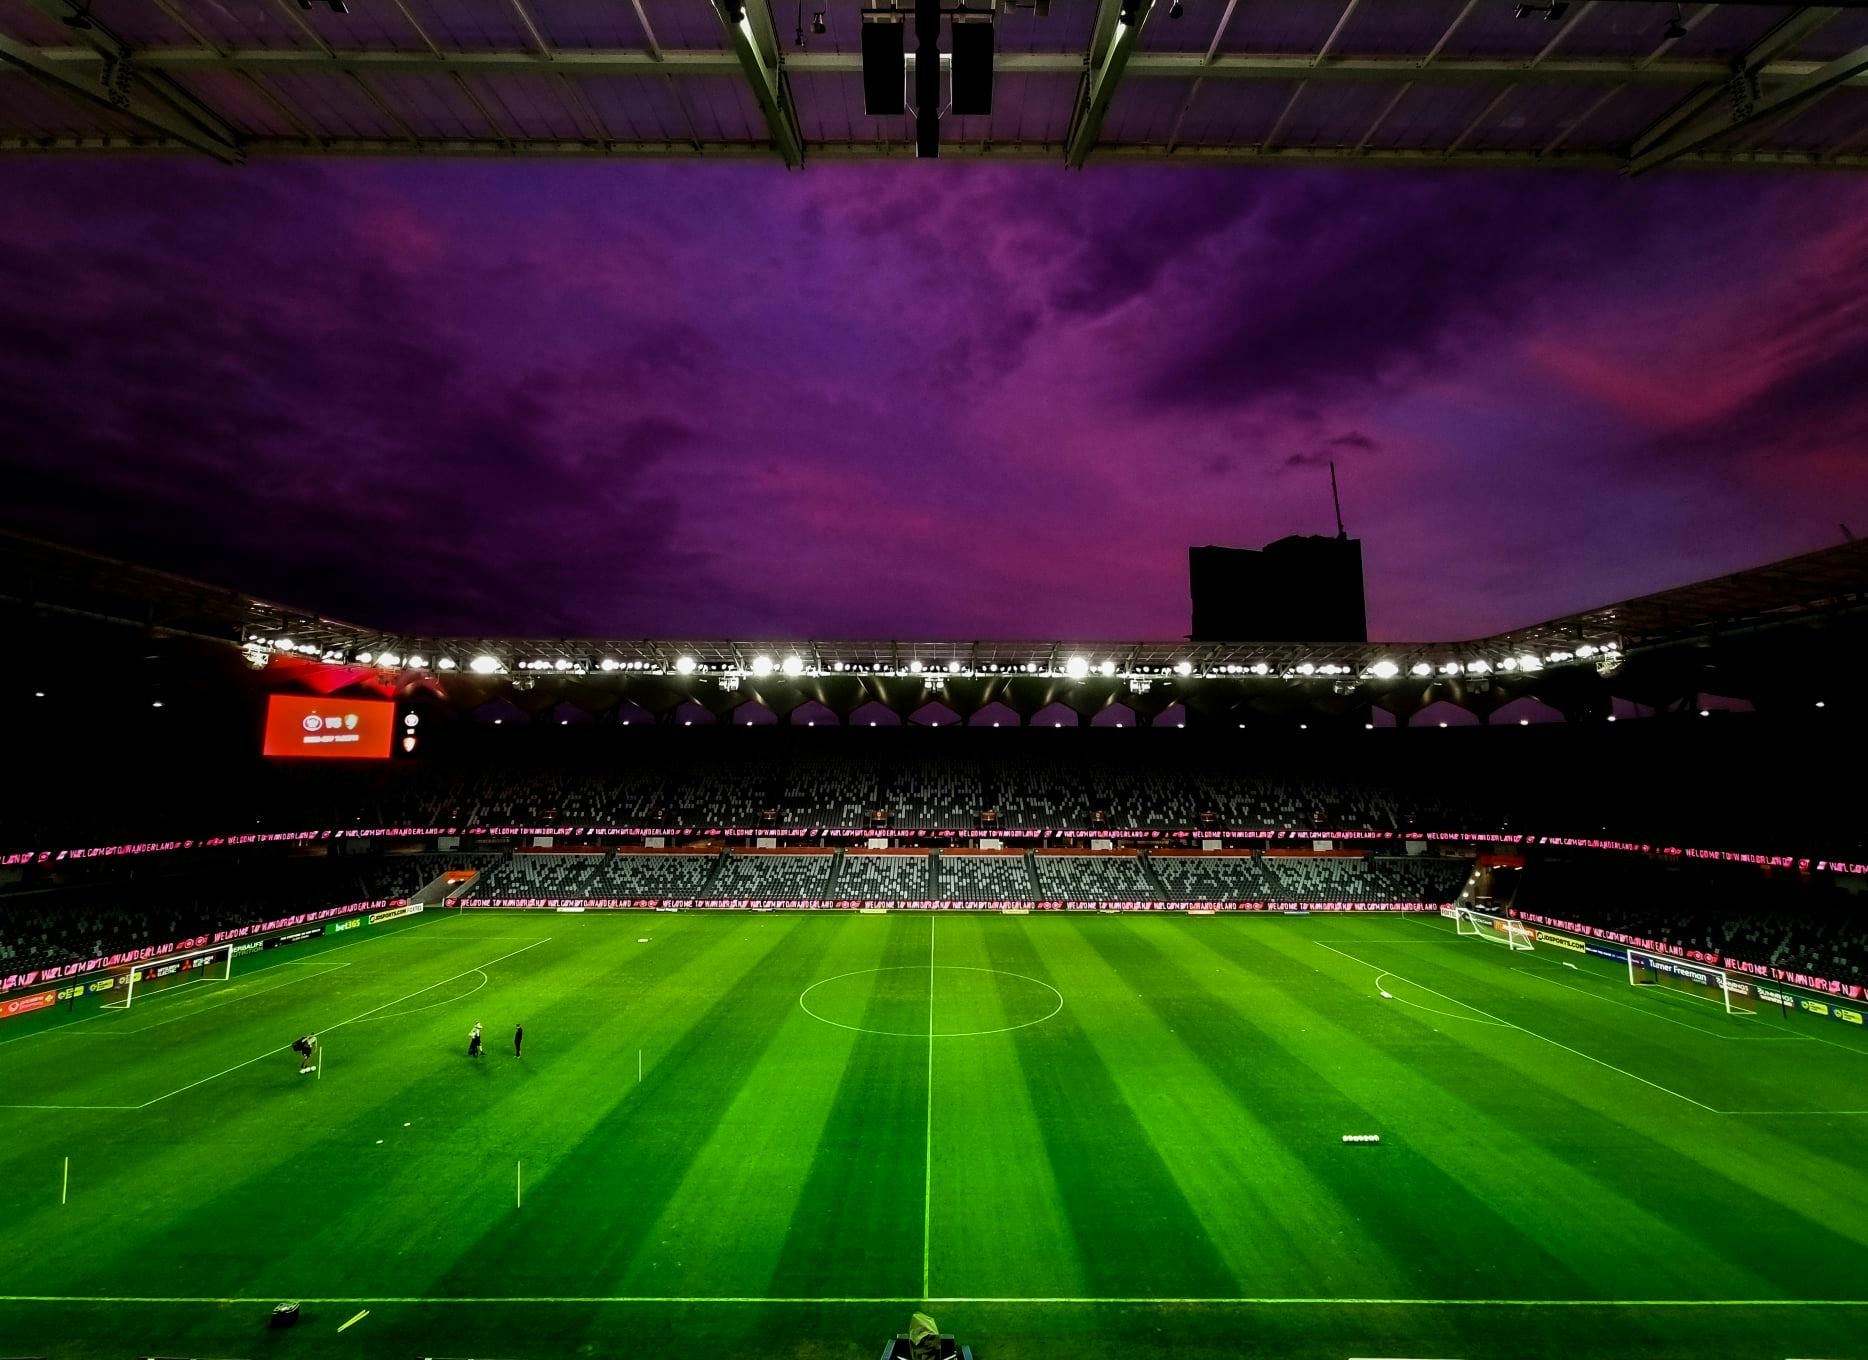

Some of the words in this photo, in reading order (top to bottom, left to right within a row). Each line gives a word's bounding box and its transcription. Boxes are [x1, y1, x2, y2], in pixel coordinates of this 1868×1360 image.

[336, 919, 360, 932] bet365
[232, 941, 263, 953] ERBALIFE
[1649, 959, 1672, 972] Turner
[1673, 965, 1707, 982] Freeman
